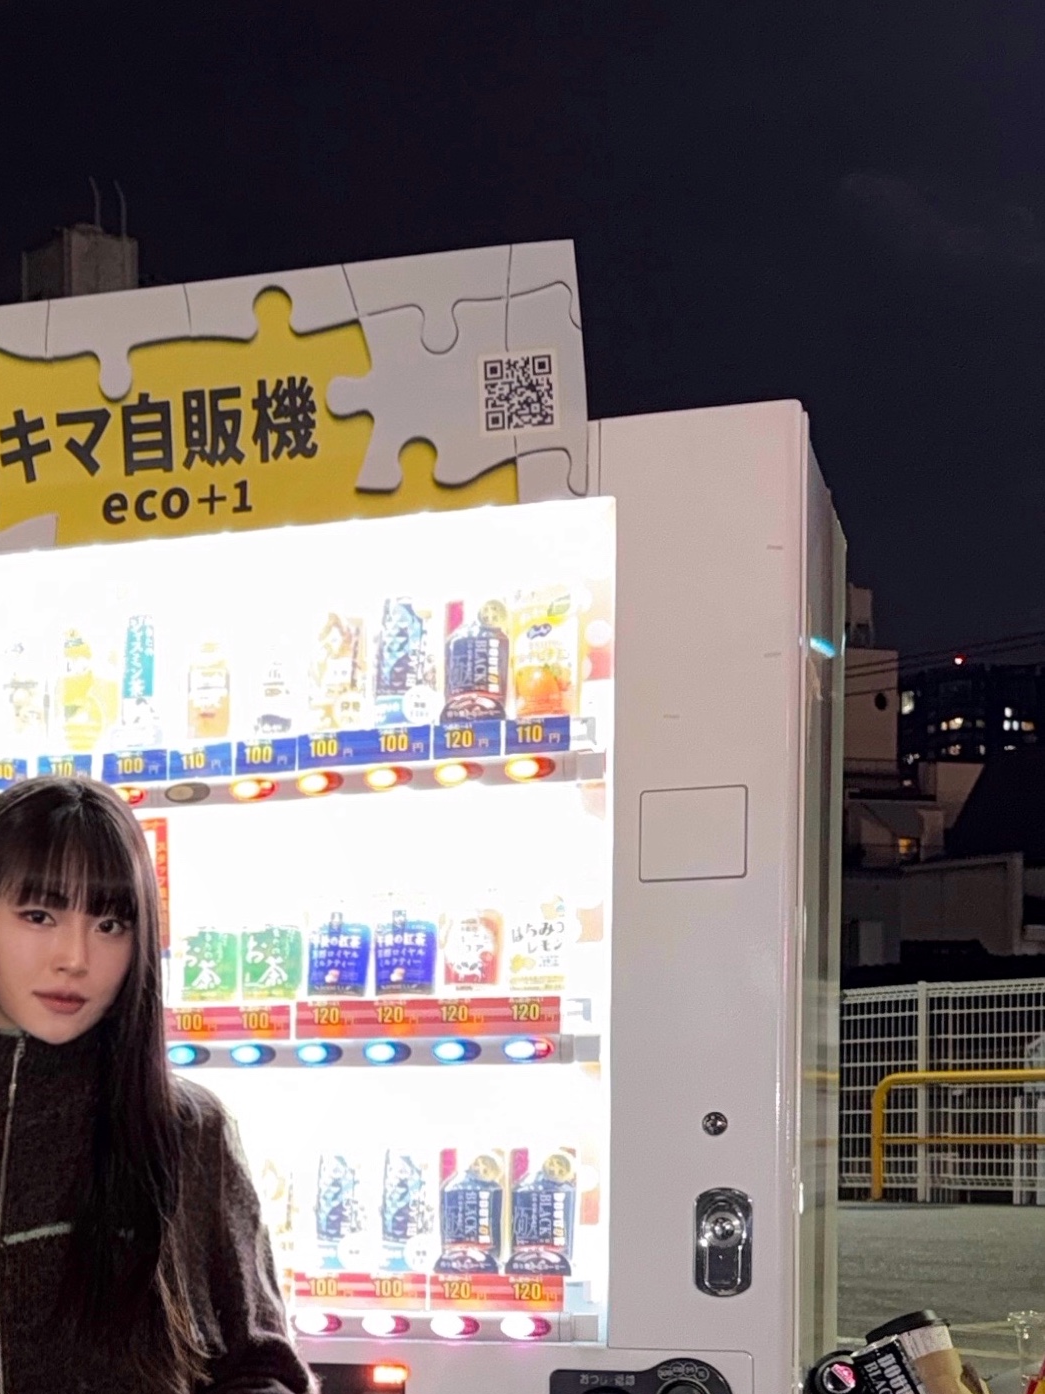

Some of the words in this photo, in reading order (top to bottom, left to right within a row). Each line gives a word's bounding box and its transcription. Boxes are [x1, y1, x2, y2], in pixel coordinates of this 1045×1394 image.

[103, 480, 253, 525] eco+1
[444, 730, 473, 748] 120
[516, 724, 543, 744] 110
[310, 739, 338, 757] 100
[379, 734, 408, 752] 100
[182, 752, 205, 770] 110
[245, 746, 273, 764] 100
[117, 757, 144, 774] 100
[511, 921, 565, 942] はちみつ
[527, 938, 562, 954] レモン
[242, 1012, 269, 1029] 100
[312, 1008, 340, 1025] 120
[376, 1006, 404, 1023] 120
[440, 1005, 468, 1022] 120
[511, 1004, 540, 1021] 120
[176, 1014, 203, 1030] 100
[464, 1191, 477, 1236] BLACK
[539, 1192, 552, 1236] BLACK
[309, 1279, 338, 1296] 100
[374, 1280, 403, 1297] 100
[443, 1283, 471, 1299] 120
[513, 1284, 541, 1300] 120
